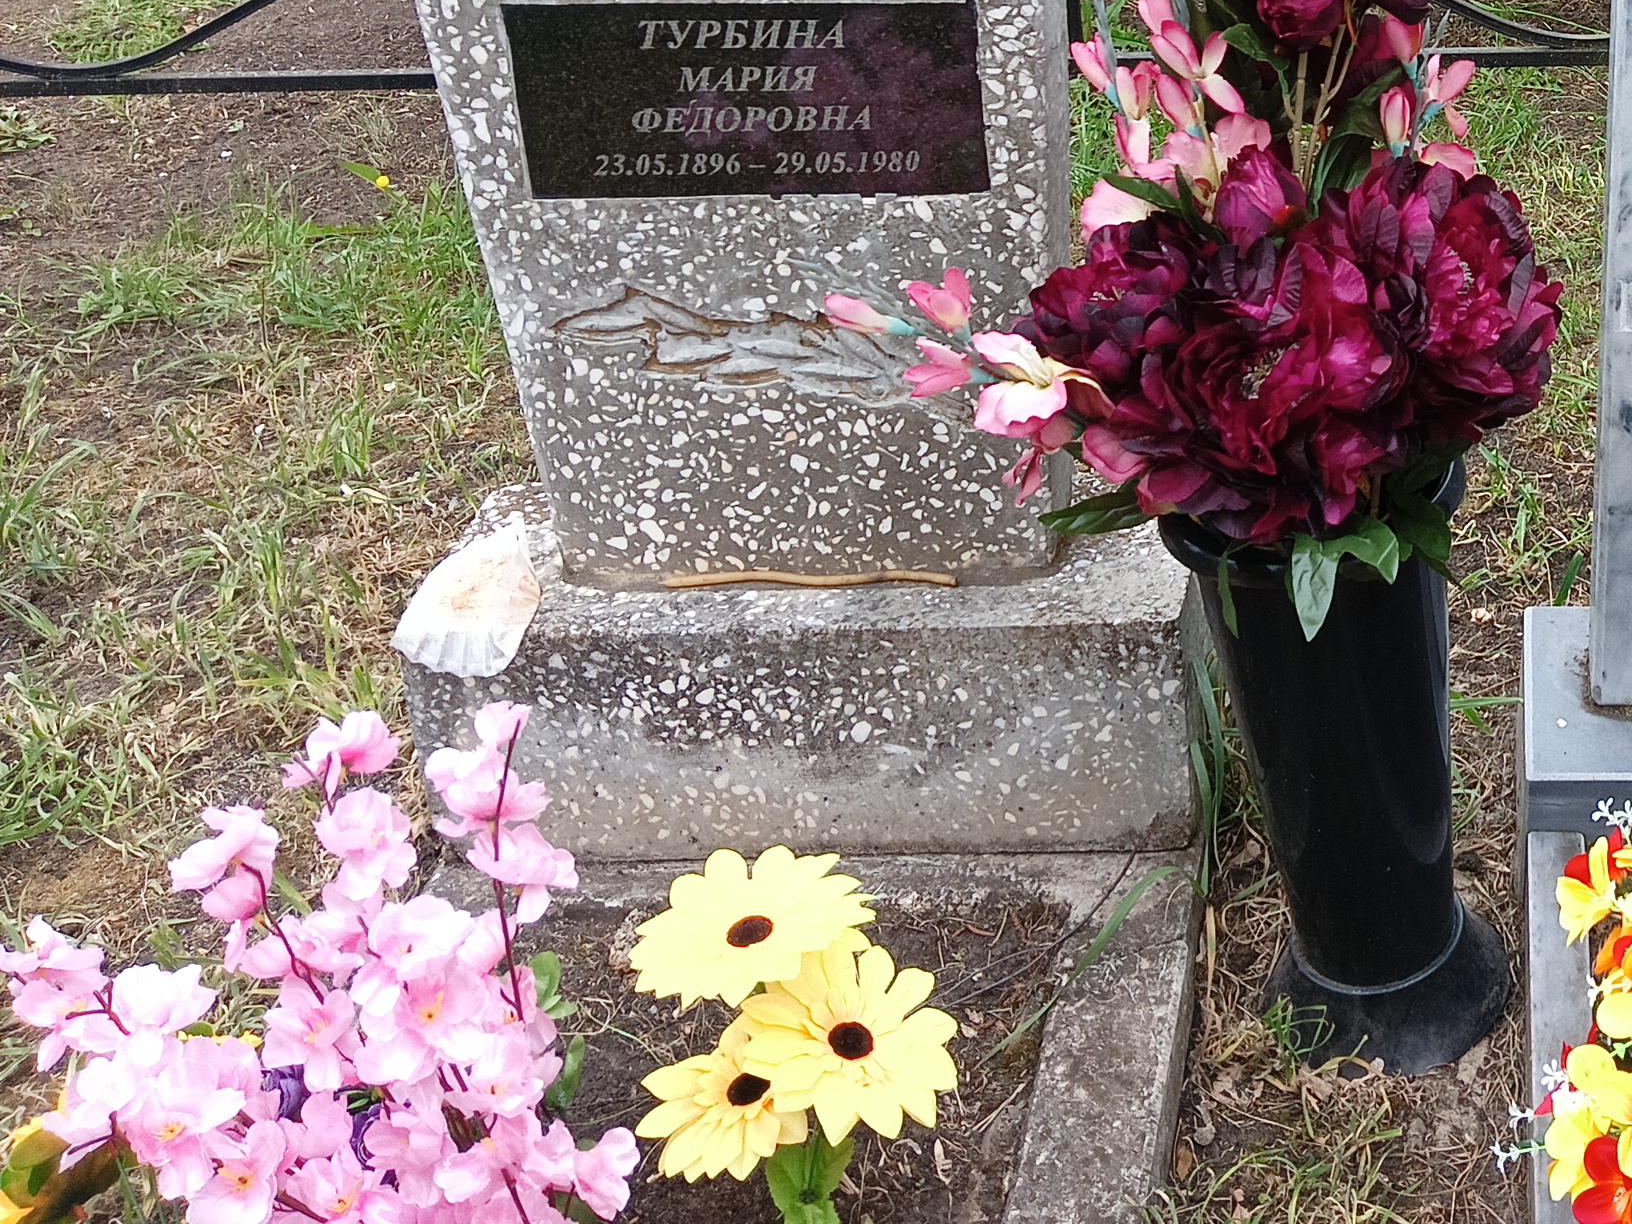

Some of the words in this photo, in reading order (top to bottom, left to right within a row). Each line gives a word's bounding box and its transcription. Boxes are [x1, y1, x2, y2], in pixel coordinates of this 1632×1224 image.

[637, 18, 846, 51] ТУРБИНА
[678, 65, 817, 93] МАРИЯ
[631, 104, 872, 138] ФЕДОРОВНА
[593, 152, 743, 177] 23.05.1896
[773, 149, 921, 174] 29.05.1980
